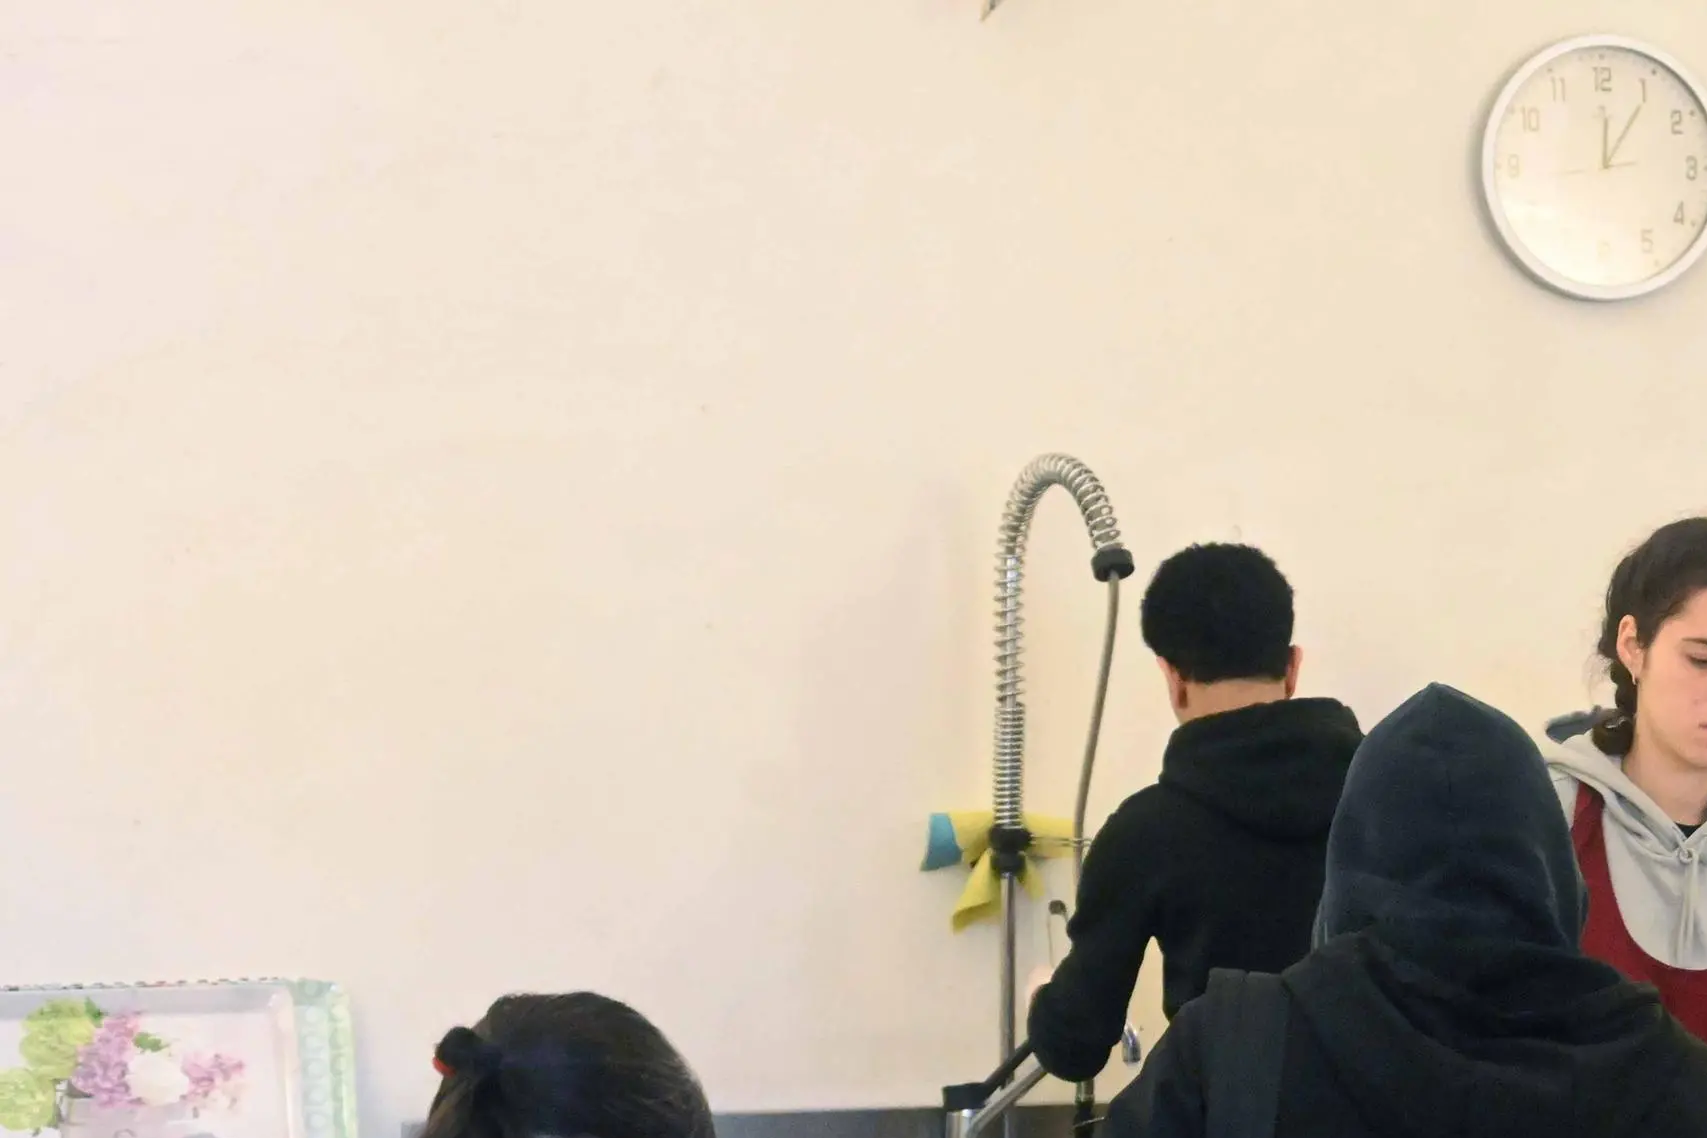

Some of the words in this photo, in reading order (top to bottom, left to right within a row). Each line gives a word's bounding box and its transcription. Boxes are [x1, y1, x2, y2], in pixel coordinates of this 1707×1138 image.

[1550, 76, 1566, 102] 11
[1592, 66, 1613, 92] 12
[1638, 78, 1647, 103] 1
[1520, 106, 1540, 132] 10
[1670, 109, 1684, 135] 2
[1685, 155, 1698, 181] 3
[1672, 200, 1685, 226] 4
[1640, 228, 1654, 254] 5
